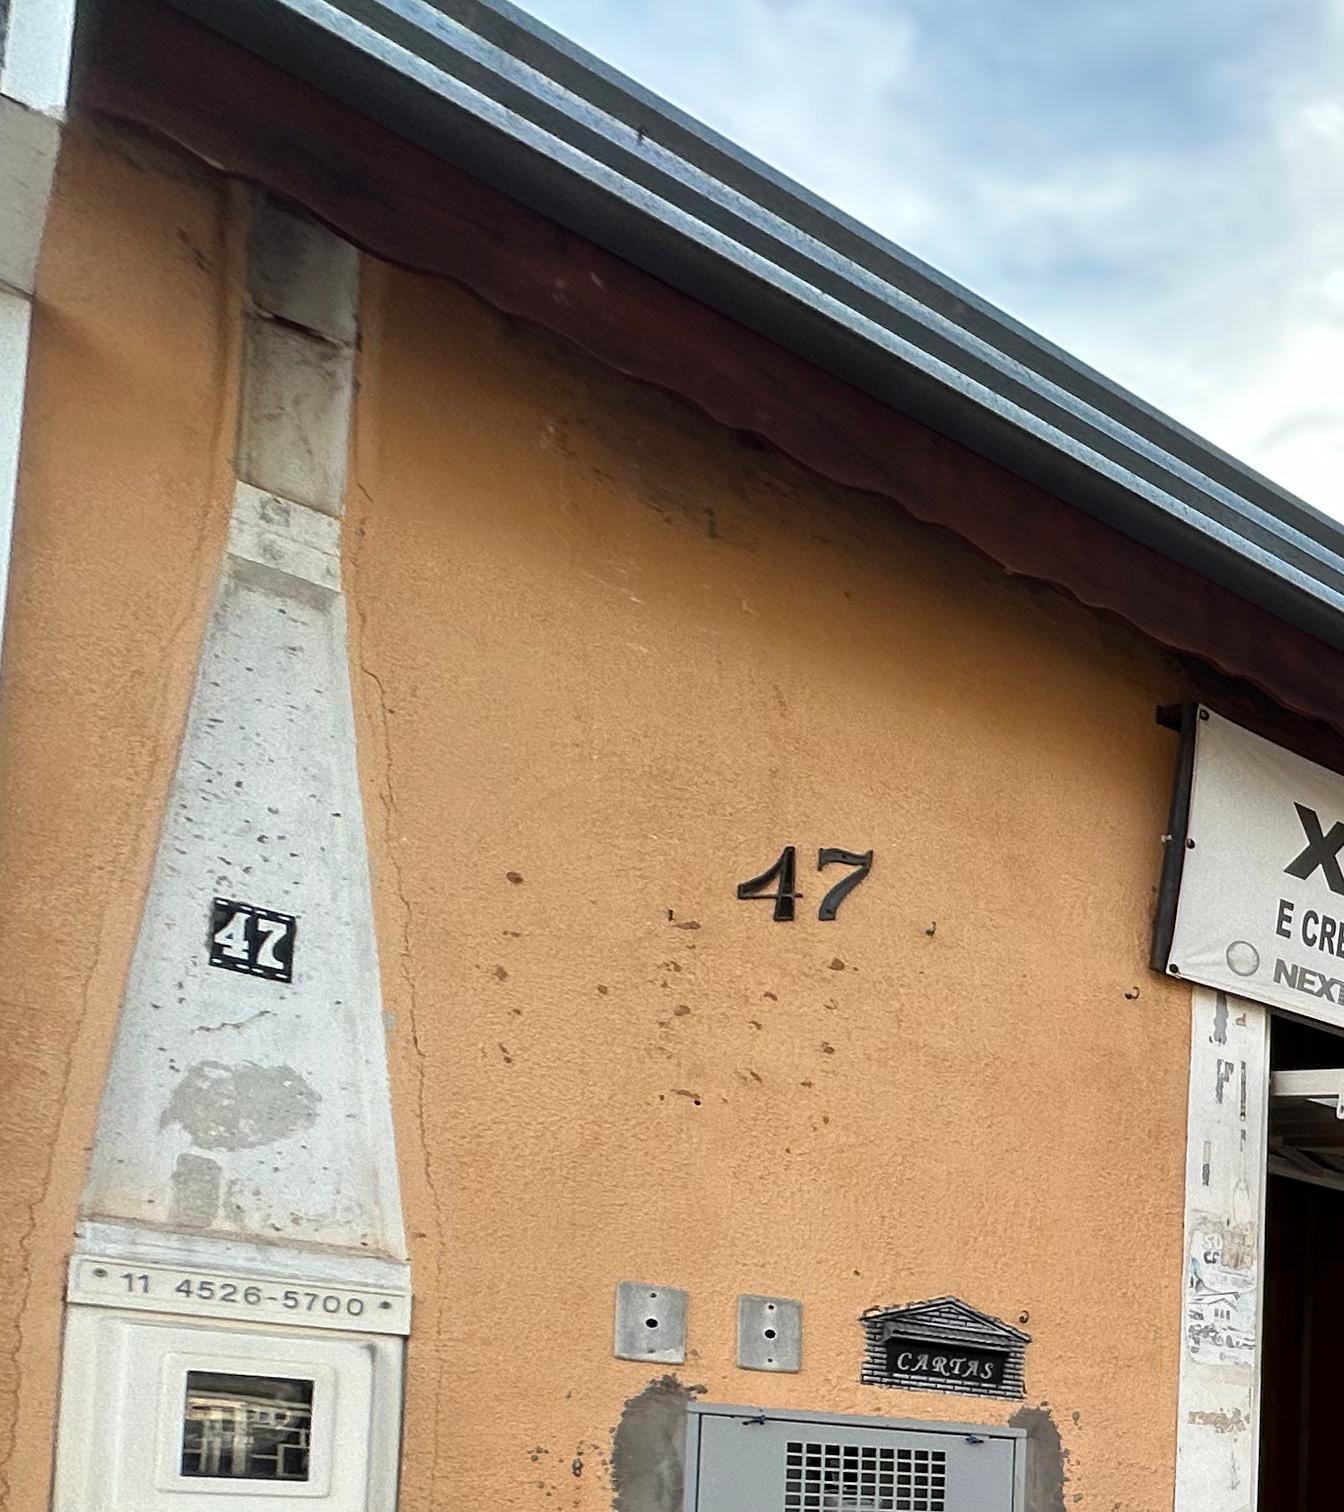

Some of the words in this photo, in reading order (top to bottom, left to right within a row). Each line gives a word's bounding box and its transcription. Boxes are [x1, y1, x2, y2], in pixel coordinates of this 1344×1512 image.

[737, 846, 873, 921] 47
[214, 912, 287, 969] 47
[1276, 898, 1295, 939] E
[121, 1272, 150, 1294] 11
[175, 1278, 365, 1317] 4526-5700
[897, 1352, 994, 1380] CARTAS
